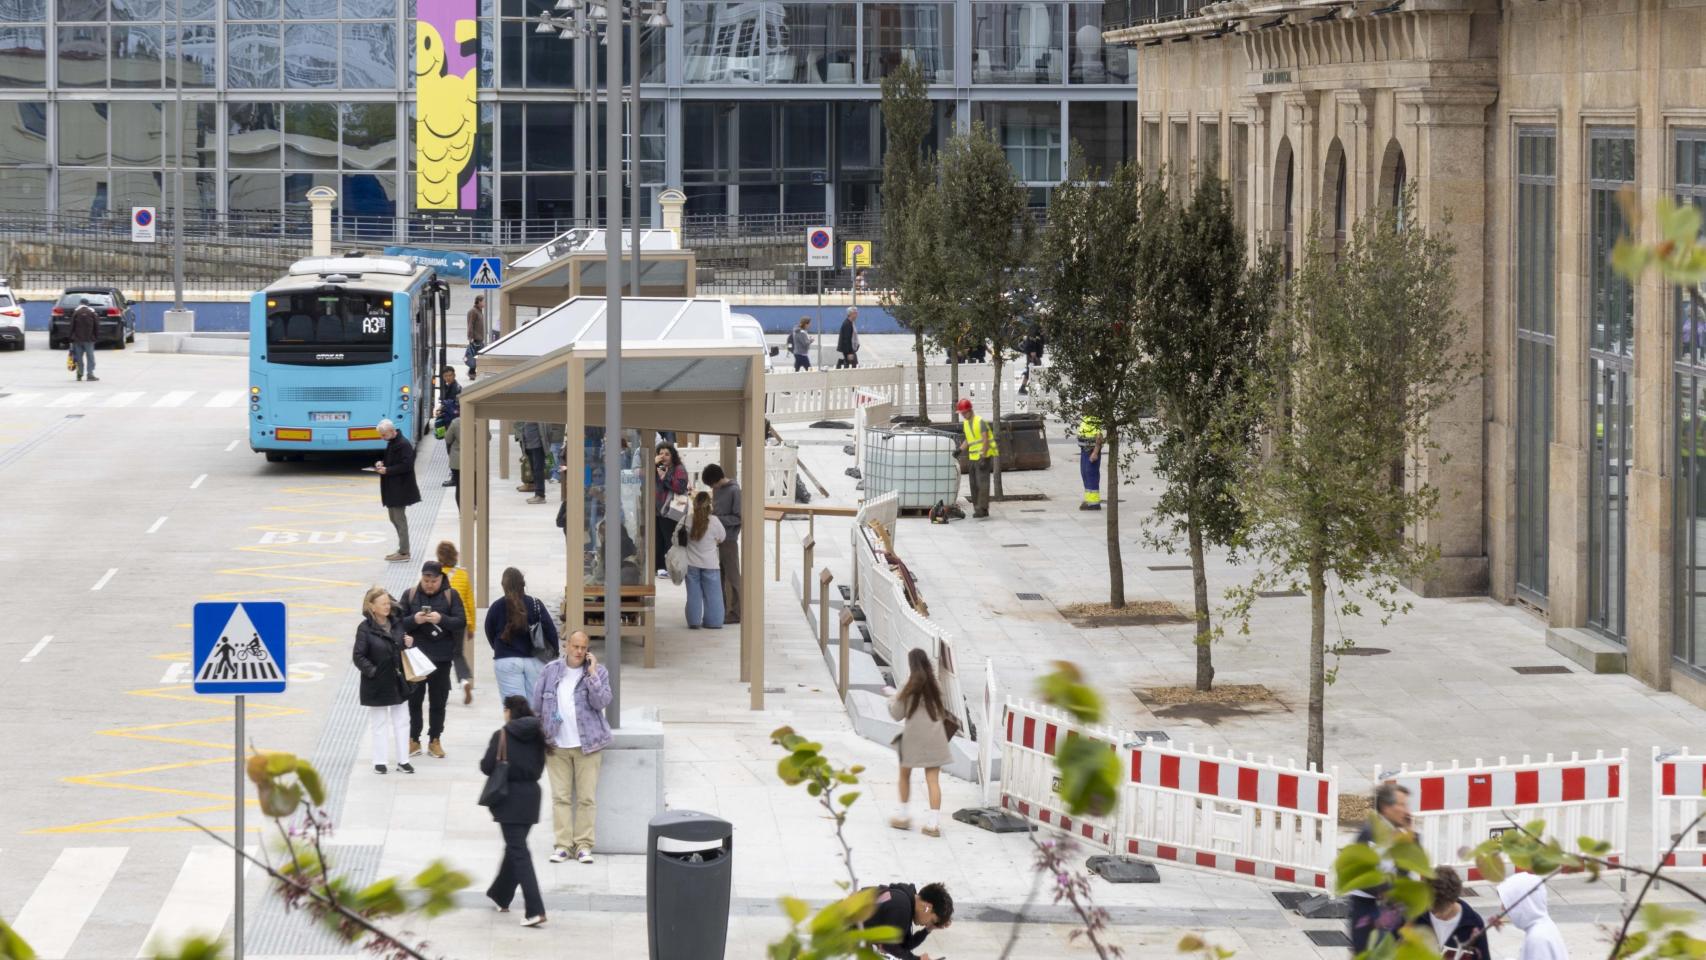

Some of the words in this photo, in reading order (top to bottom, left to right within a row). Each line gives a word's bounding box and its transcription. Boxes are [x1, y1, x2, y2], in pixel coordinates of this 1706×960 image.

[315, 353, 345, 361] OTOKAR
[258, 531, 388, 544] BUS
[159, 662, 332, 683] BS
